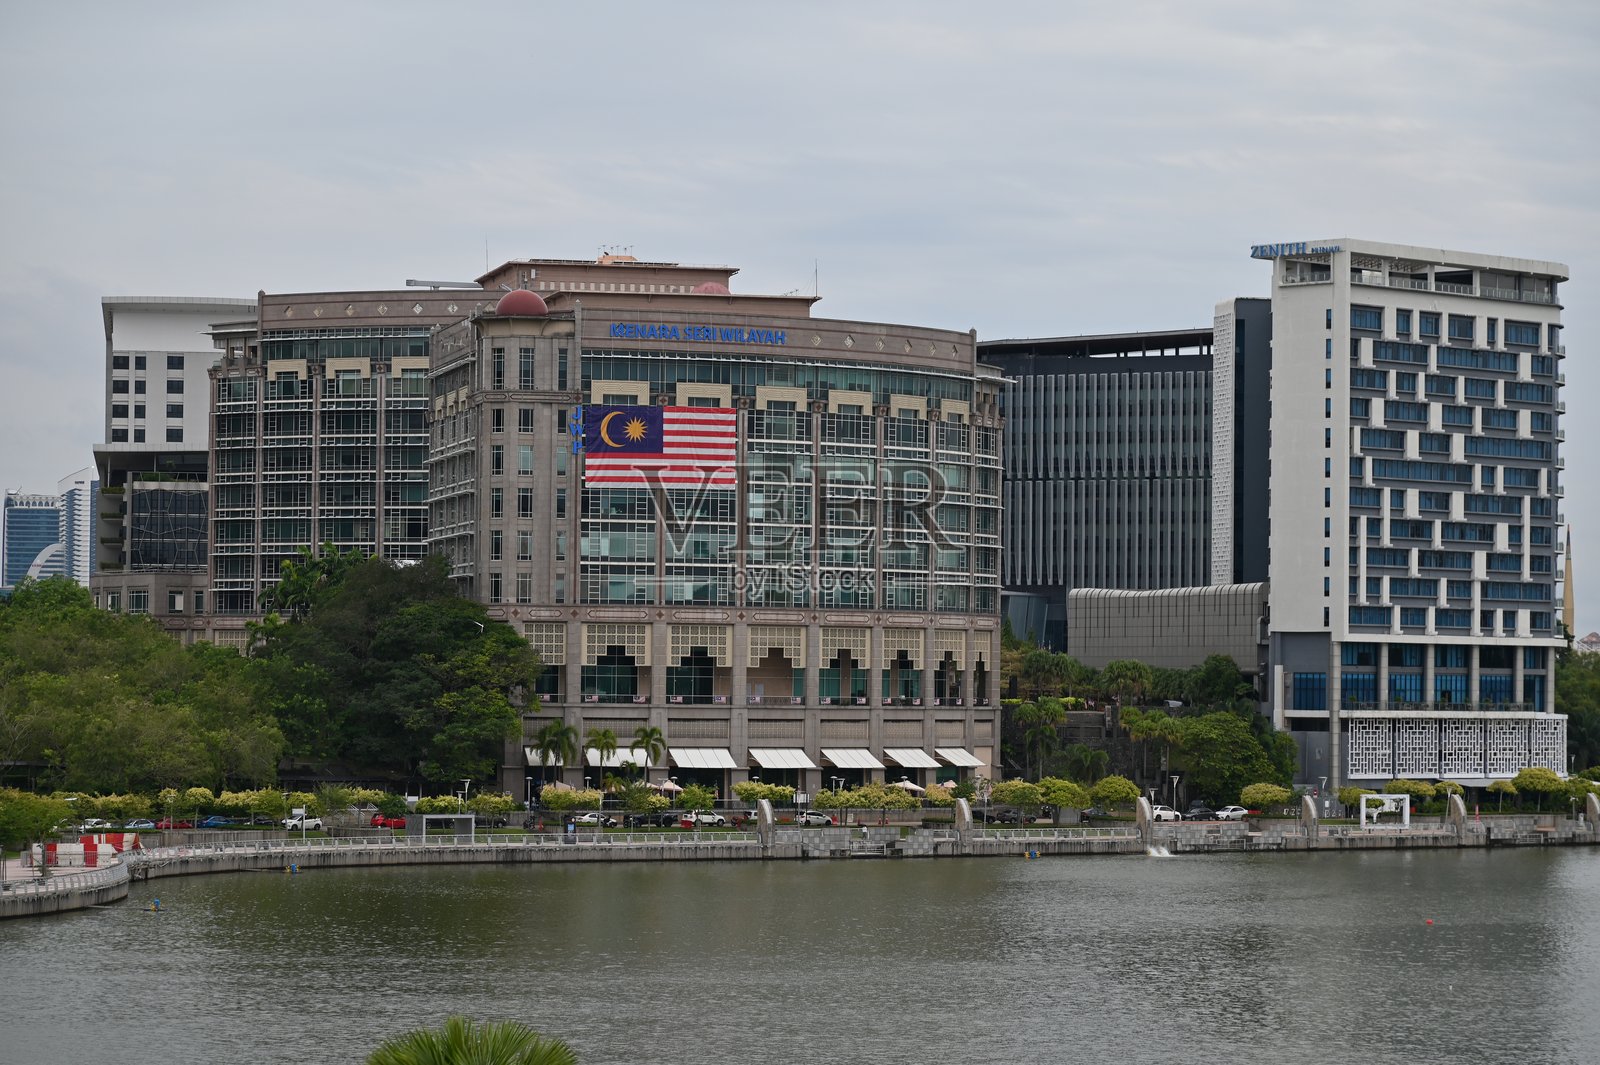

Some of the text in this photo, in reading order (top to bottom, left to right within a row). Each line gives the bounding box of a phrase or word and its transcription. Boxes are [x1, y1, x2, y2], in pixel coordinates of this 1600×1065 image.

[1250, 242, 1306, 258] ZENITH
[610, 323, 786, 345] MENARA SERI WILAYAH
